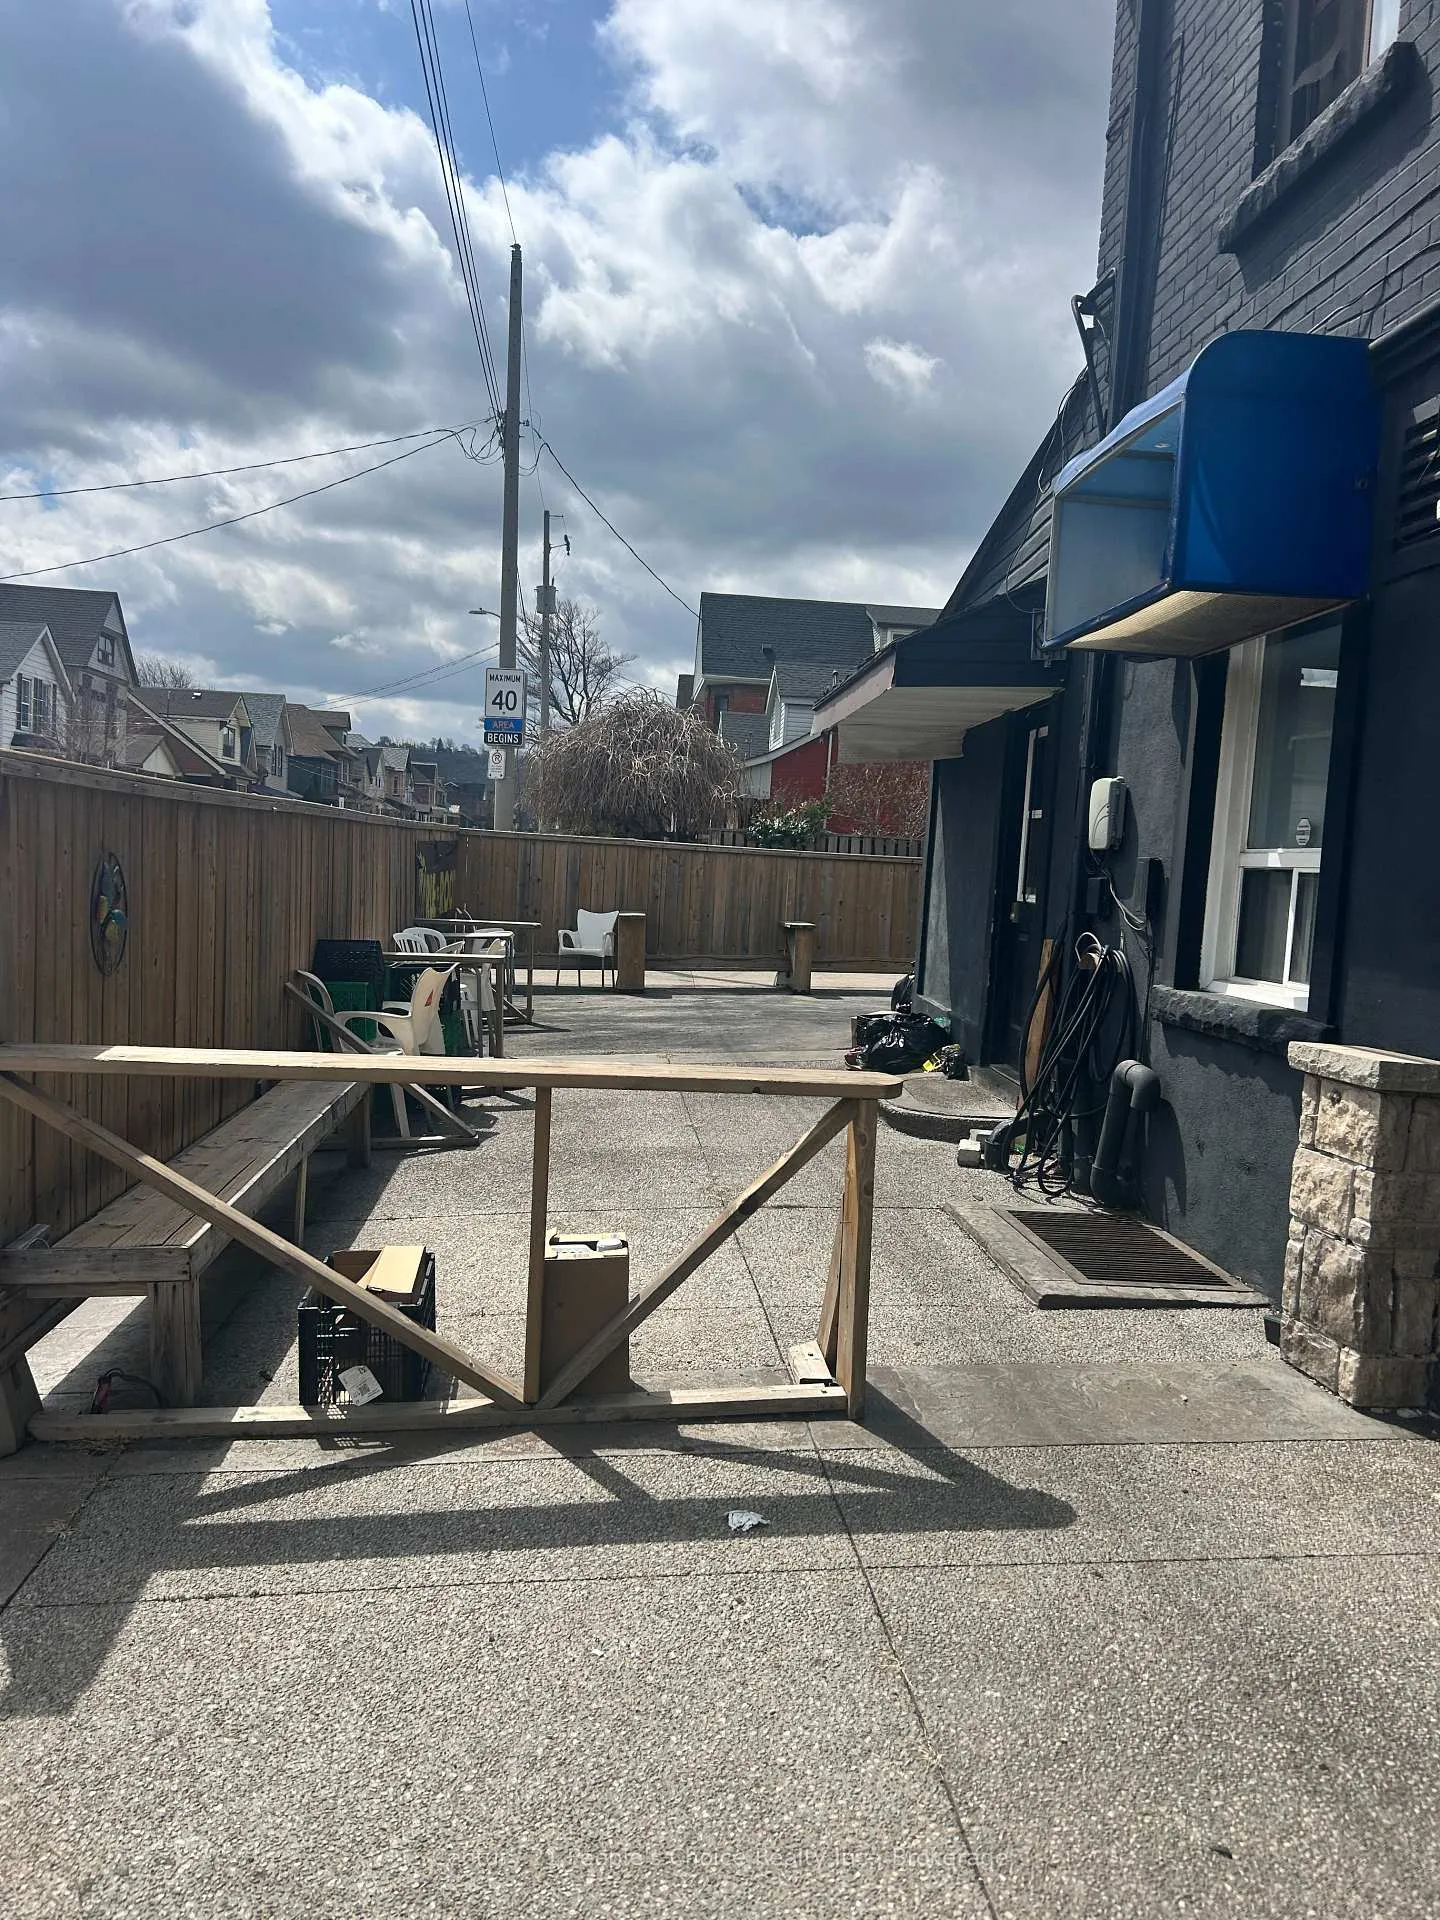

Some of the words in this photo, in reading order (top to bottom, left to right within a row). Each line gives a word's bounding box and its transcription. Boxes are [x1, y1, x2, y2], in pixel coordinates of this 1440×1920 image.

[490, 674, 521, 683] MAXIMUM
[491, 690, 518, 711] 40
[493, 720, 515, 729] AREA
[487, 732, 519, 744] BEGINS
